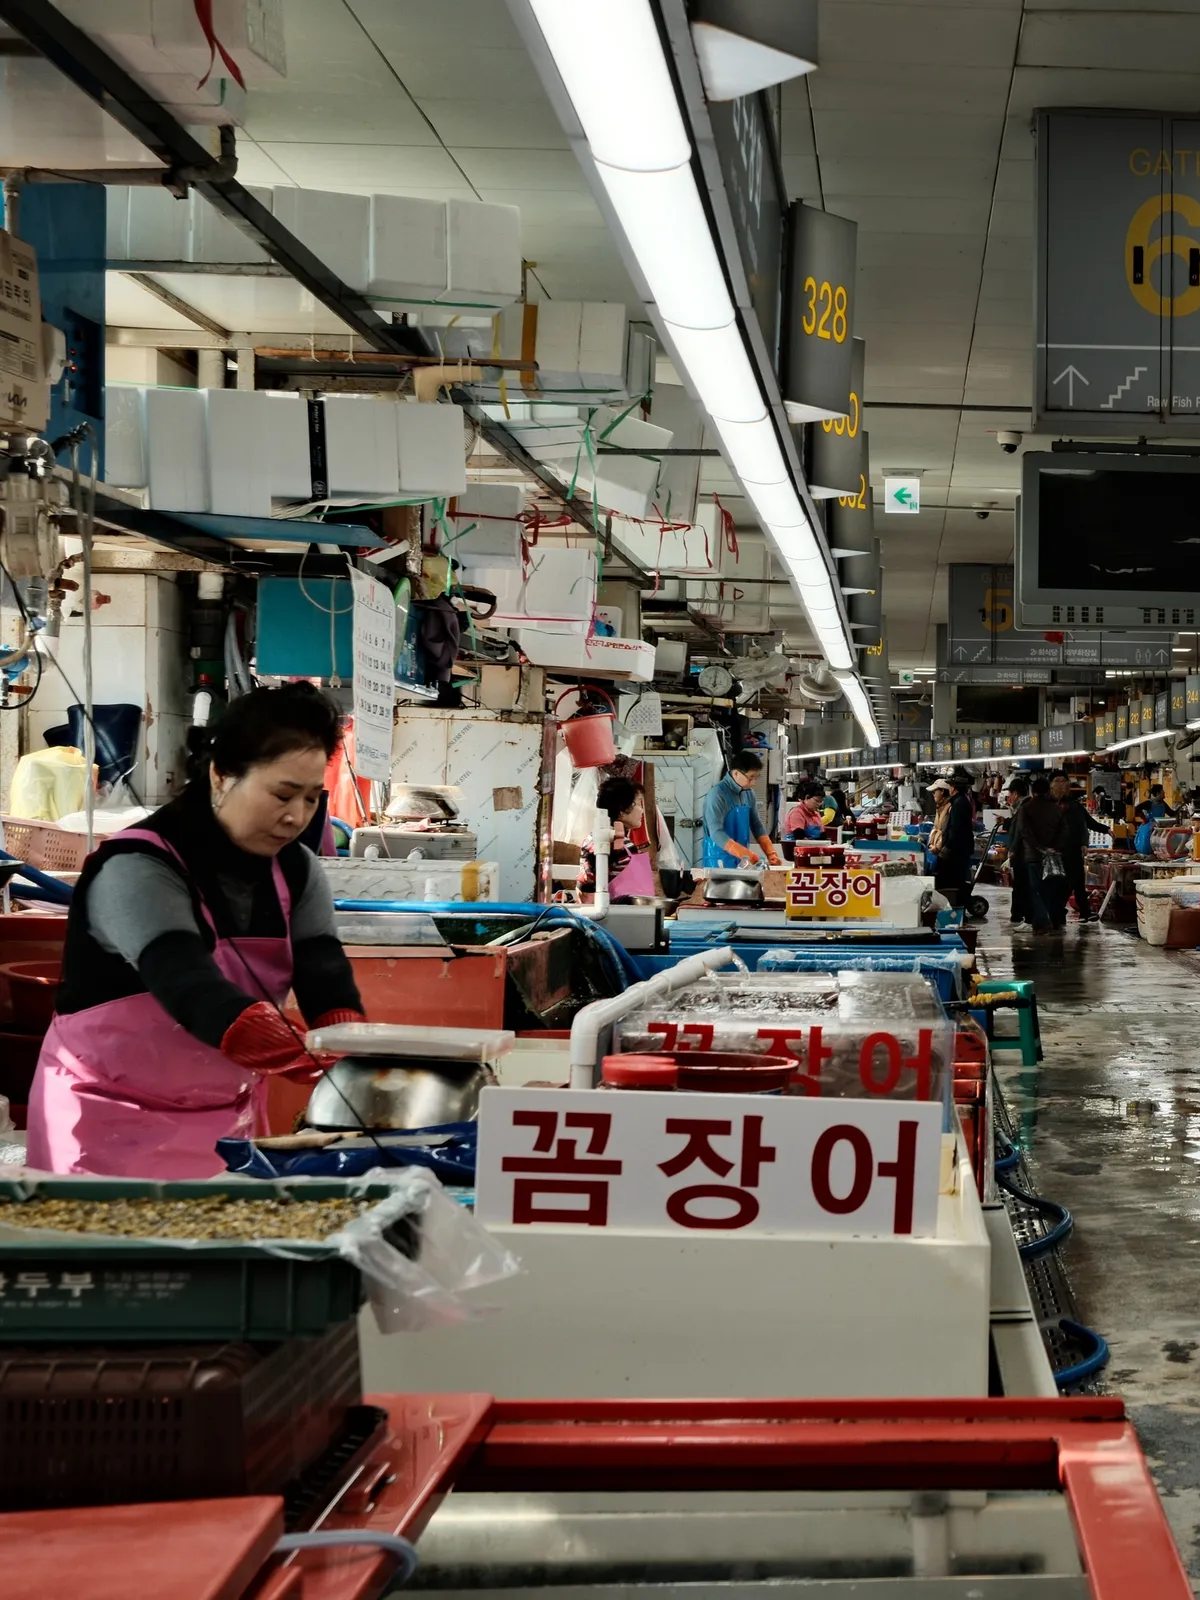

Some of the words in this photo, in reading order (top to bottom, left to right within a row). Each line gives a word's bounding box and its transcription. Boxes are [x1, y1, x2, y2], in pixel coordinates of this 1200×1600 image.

[802, 276, 848, 344] 328
[1147, 396, 1168, 408] Raw
[1172, 396, 1192, 408] Fish
[983, 588, 1014, 632] 5
[1172, 696, 1183, 709] 243
[1187, 690, 1198, 704] 244
[786, 872, 881, 907] 꼼장어
[502, 1110, 919, 1234] 꼼장어
[0, 1271, 95, 1298] 두부
